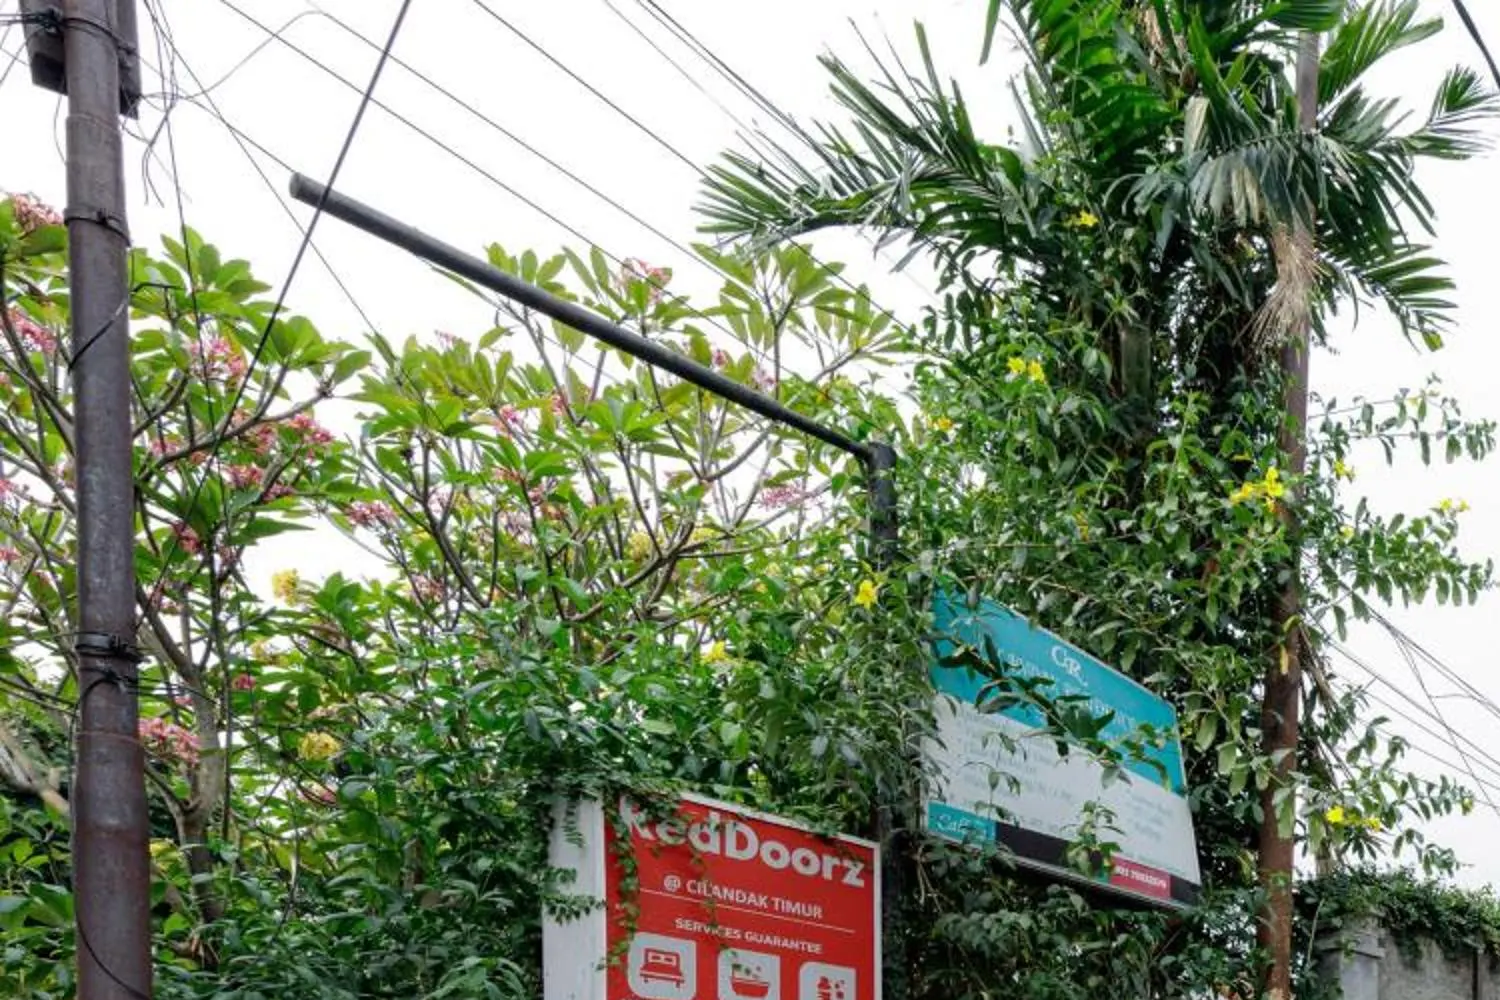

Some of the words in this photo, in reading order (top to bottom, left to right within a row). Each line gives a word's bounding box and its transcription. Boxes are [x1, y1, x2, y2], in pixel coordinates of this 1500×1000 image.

[663, 874, 681, 892] @
[686, 879, 768, 909] CILANDAK
[771, 896, 823, 919] TIMUR
[674, 917, 742, 940] SERVICES
[744, 930, 823, 955] GUARANTEE
